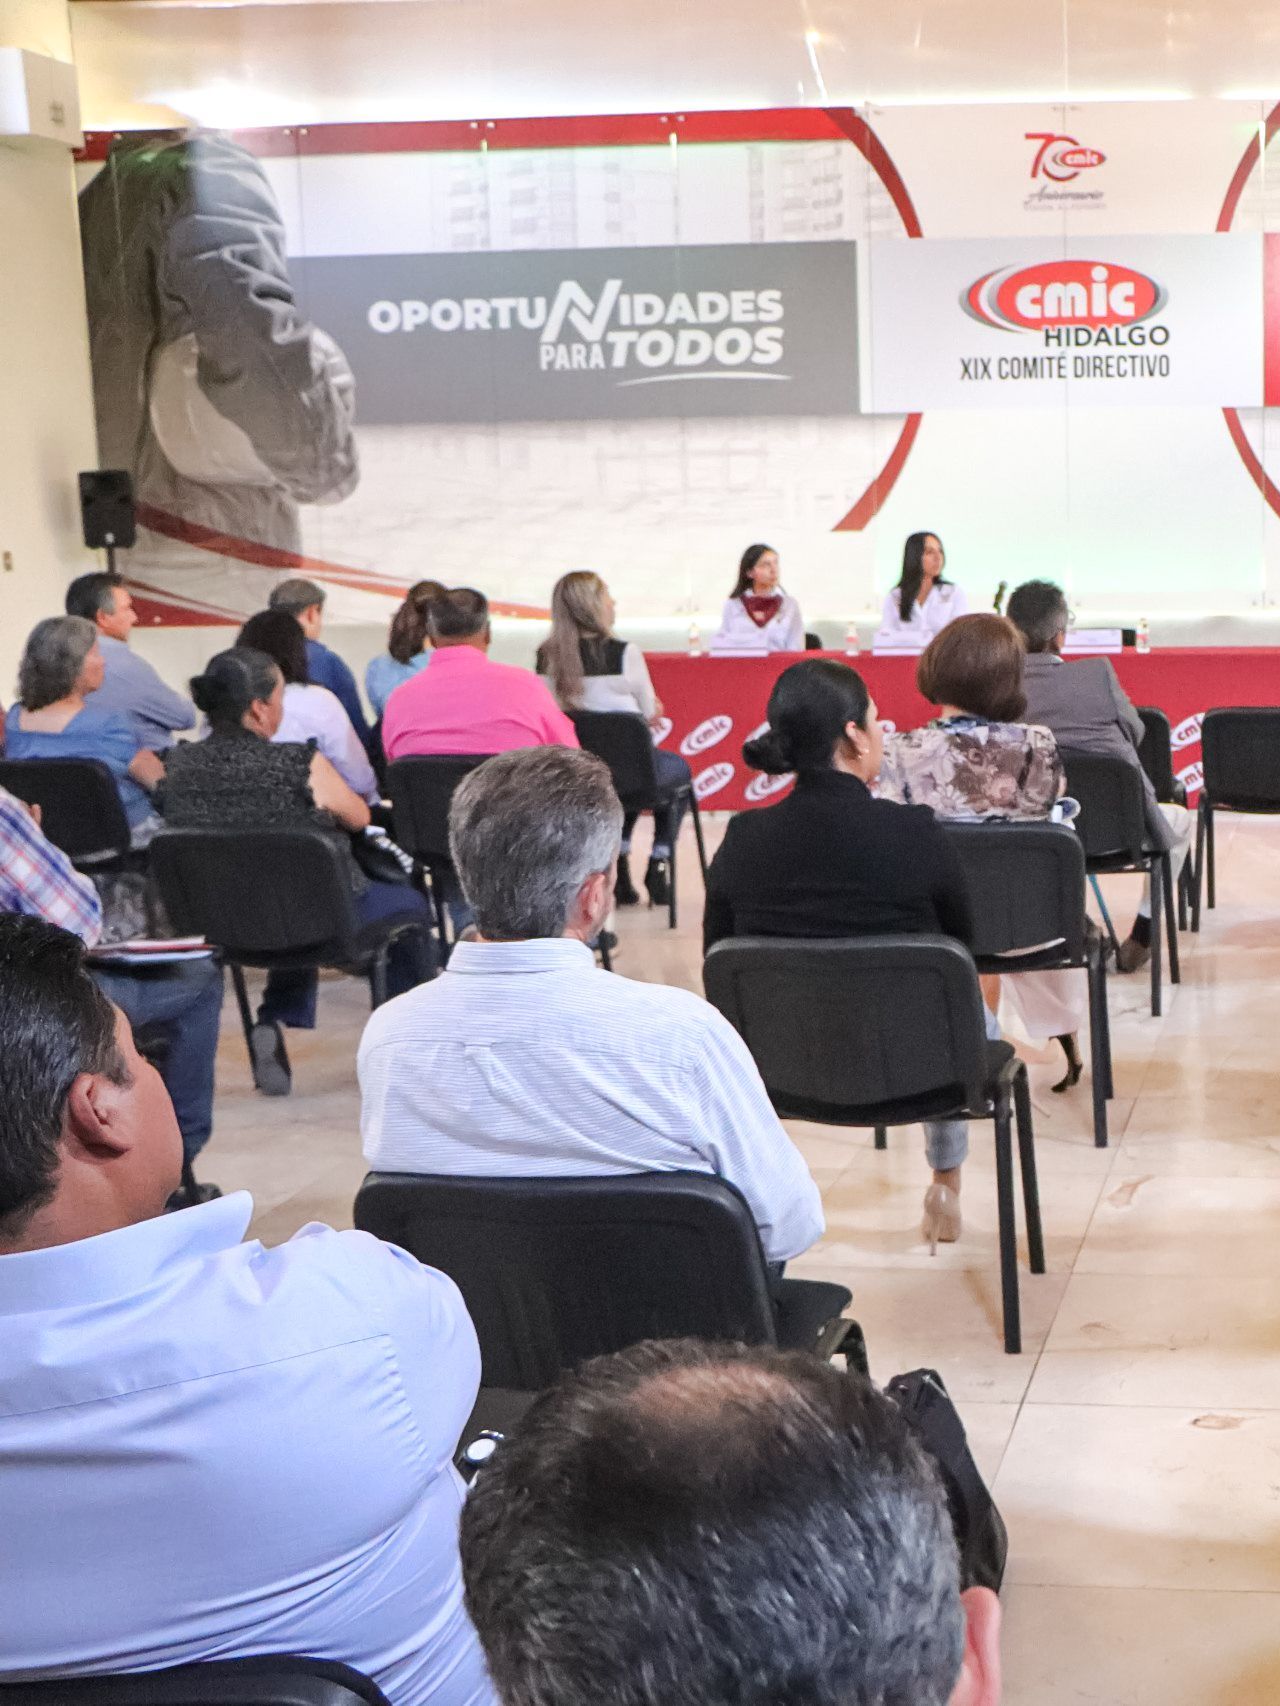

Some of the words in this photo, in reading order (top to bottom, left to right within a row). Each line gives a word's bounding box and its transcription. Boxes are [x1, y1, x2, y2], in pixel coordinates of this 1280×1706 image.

[368, 279, 784, 343] OPORTUNIDADES
[1015, 265, 1135, 318] cmic
[540, 342, 604, 370] PARA
[606, 327, 784, 367] TODOS
[1044, 325, 1170, 347] HIDALGO
[960, 357, 992, 380] XIX
[999, 351, 1067, 379] COMITÉ
[1073, 355, 1170, 378] DIRECTIVO
